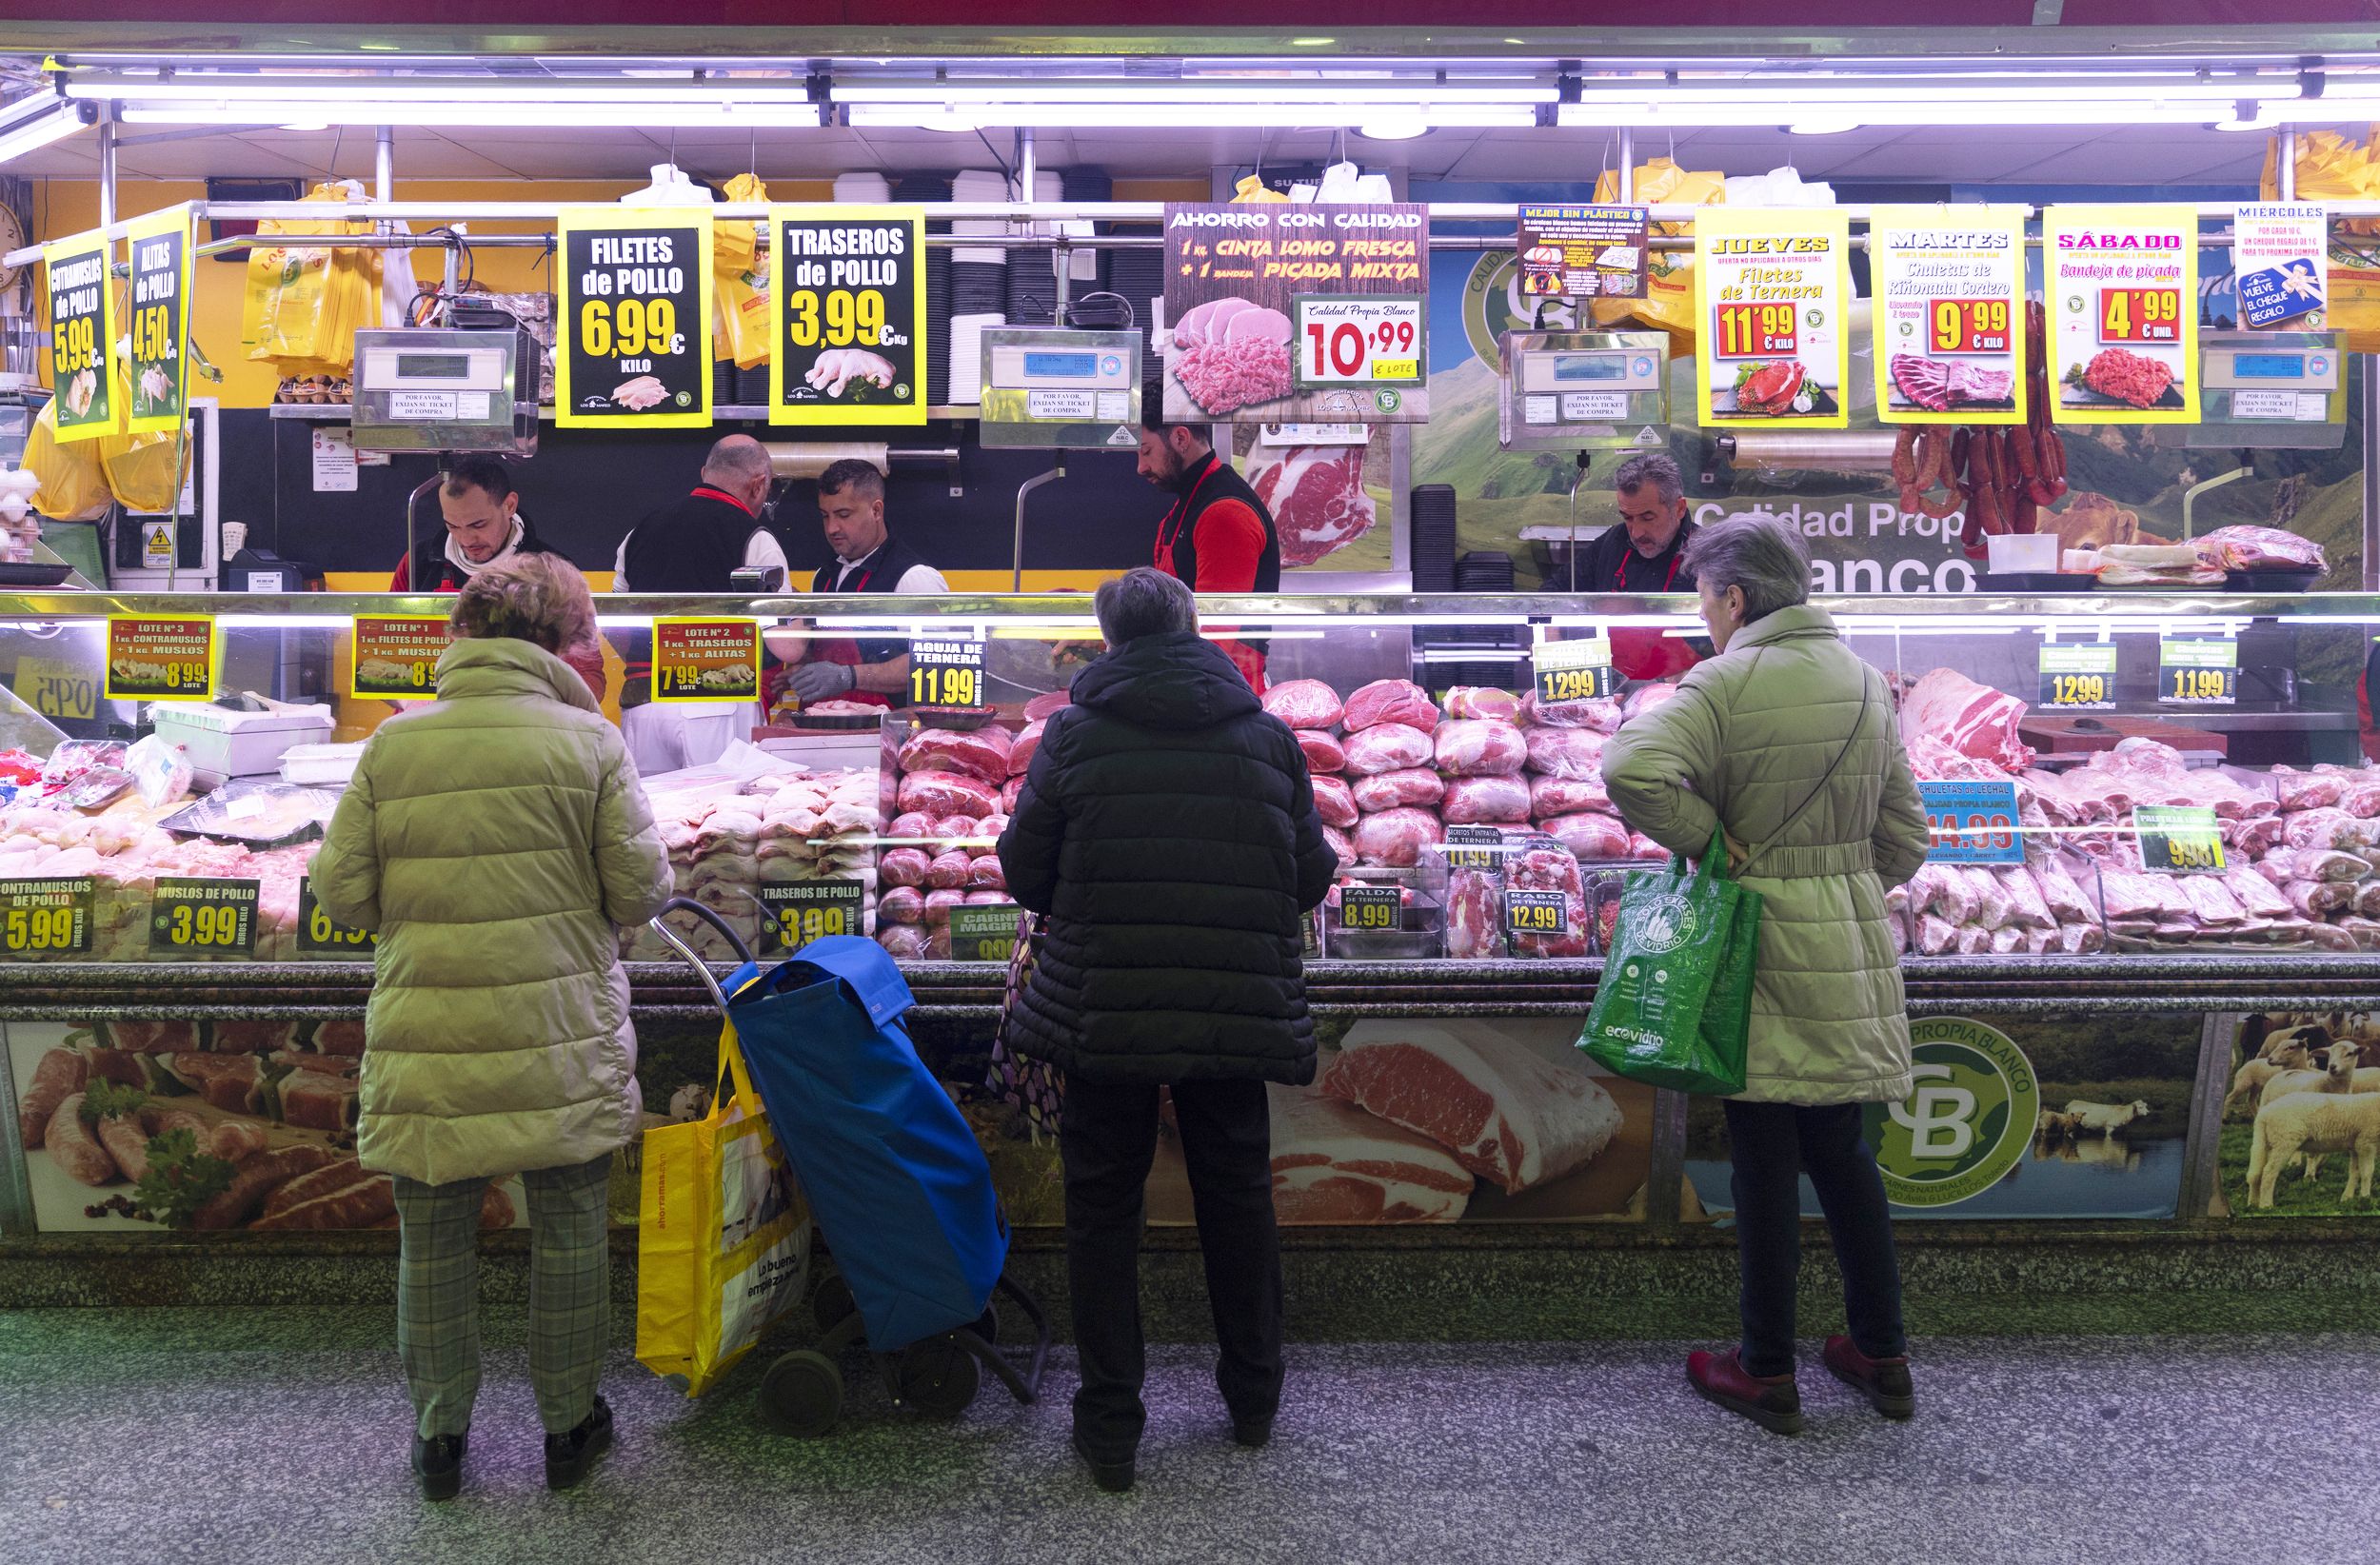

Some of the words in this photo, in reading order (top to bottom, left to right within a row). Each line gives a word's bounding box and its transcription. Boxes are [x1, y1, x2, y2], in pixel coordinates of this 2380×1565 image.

[1170, 212, 1269, 229] AHORRO
[1278, 213, 1324, 228] CON
[1334, 213, 1422, 230] CALIDAD
[1526, 209, 1559, 218] MEJOR
[1563, 209, 1579, 218] SIN
[1583, 208, 1630, 219] PLÁSTICO
[2238, 206, 2323, 217] MIÉRCOLES
[788, 228, 904, 255] TRASEROS
[1710, 236, 1830, 254] JUEVES
[1889, 232, 2008, 248] MARTES
[2058, 230, 2182, 249] SÁBADO
[141, 242, 169, 272] ALITAS
[591, 236, 674, 265] FILETES
[1216, 240, 1273, 260] CINTA
[1279, 240, 1336, 256] LOMO
[1341, 240, 1416, 262] FRESCA
[797, 261, 826, 287] de
[831, 259, 897, 286] POLLO
[1739, 267, 1803, 284] Filetes
[1906, 262, 1969, 276] Chuletas
[1974, 263, 1992, 276] de
[2060, 264, 2113, 280] Bandeja
[2116, 265, 2132, 278] de
[2136, 264, 2181, 280] picada
[136, 277, 147, 303] de
[149, 271, 174, 300] POLLO
[583, 269, 612, 295] de
[617, 267, 684, 295] POLLO
[1889, 280, 1957, 295] Riñonada
[1961, 281, 2011, 295] Cordero
[2243, 282, 2274, 297] VUELVE
[1720, 286, 1743, 301] de
[1750, 285, 1823, 301] Ternera
[2247, 301, 2255, 310] EL
[2256, 291, 2289, 308] CHEQUE
[55, 295, 69, 319] de
[69, 287, 98, 316] POLLO
[1308, 305, 1348, 316] Calidad
[1350, 305, 1380, 320] Propia
[1383, 305, 1415, 316] Blanco
[2106, 290, 2177, 338] 4'99
[2251, 306, 2284, 323] REGALO
[1721, 306, 1794, 353] 11'99
[1936, 301, 2007, 350] 9'99
[2142, 324, 2151, 338] €
[2153, 326, 2173, 337] UND.
[1764, 336, 1773, 350] €
[1775, 338, 1794, 349] KILO
[1973, 334, 1981, 348] €
[1984, 337, 2004, 348] KILO
[621, 359, 651, 373] KILO
[688, 639, 752, 647] TRASEROS
[913, 643, 961, 653] AGUJA
[963, 644, 982, 654] DE
[914, 653, 981, 664] TERNERA
[912, 668, 974, 704] 11,99
[1918, 785, 1962, 794] CHULETAS
[1977, 785, 2009, 794] LECHAL
[1927, 814, 2013, 849] 14.99
[13, 895, 29, 906] DE
[31, 895, 69, 906] POLLO
[157, 887, 203, 899] MUSLOS
[206, 888, 220, 899] DE
[222, 889, 255, 900] POLLO
[763, 887, 814, 899] TRASEROS
[816, 887, 828, 898] DE
[830, 886, 860, 898] POLLO
[240, 906, 248, 921] KILO
[1345, 904, 1390, 926] 8.99
[1512, 906, 1556, 928] 12.99
[1638, 900, 1662, 921] SOLO
[1664, 897, 1691, 930] ENVASES
[7, 909, 72, 951] 5,99
[171, 904, 237, 945] 3,99
[237, 922, 248, 945] EUROS
[781, 907, 843, 948] 3,99
[1636, 931, 1645, 943] DE
[1646, 935, 1682, 951] VIDRIO
[1605, 1025, 1664, 1046] ecovidrio
[1910, 1023, 1976, 1043] PROPIA
[1977, 1033, 2031, 1093] BLANCO
[658, 1153, 666, 1229] ahorramas.com
[759, 1265, 766, 1278] Lo
[767, 1253, 797, 1273] bueno
